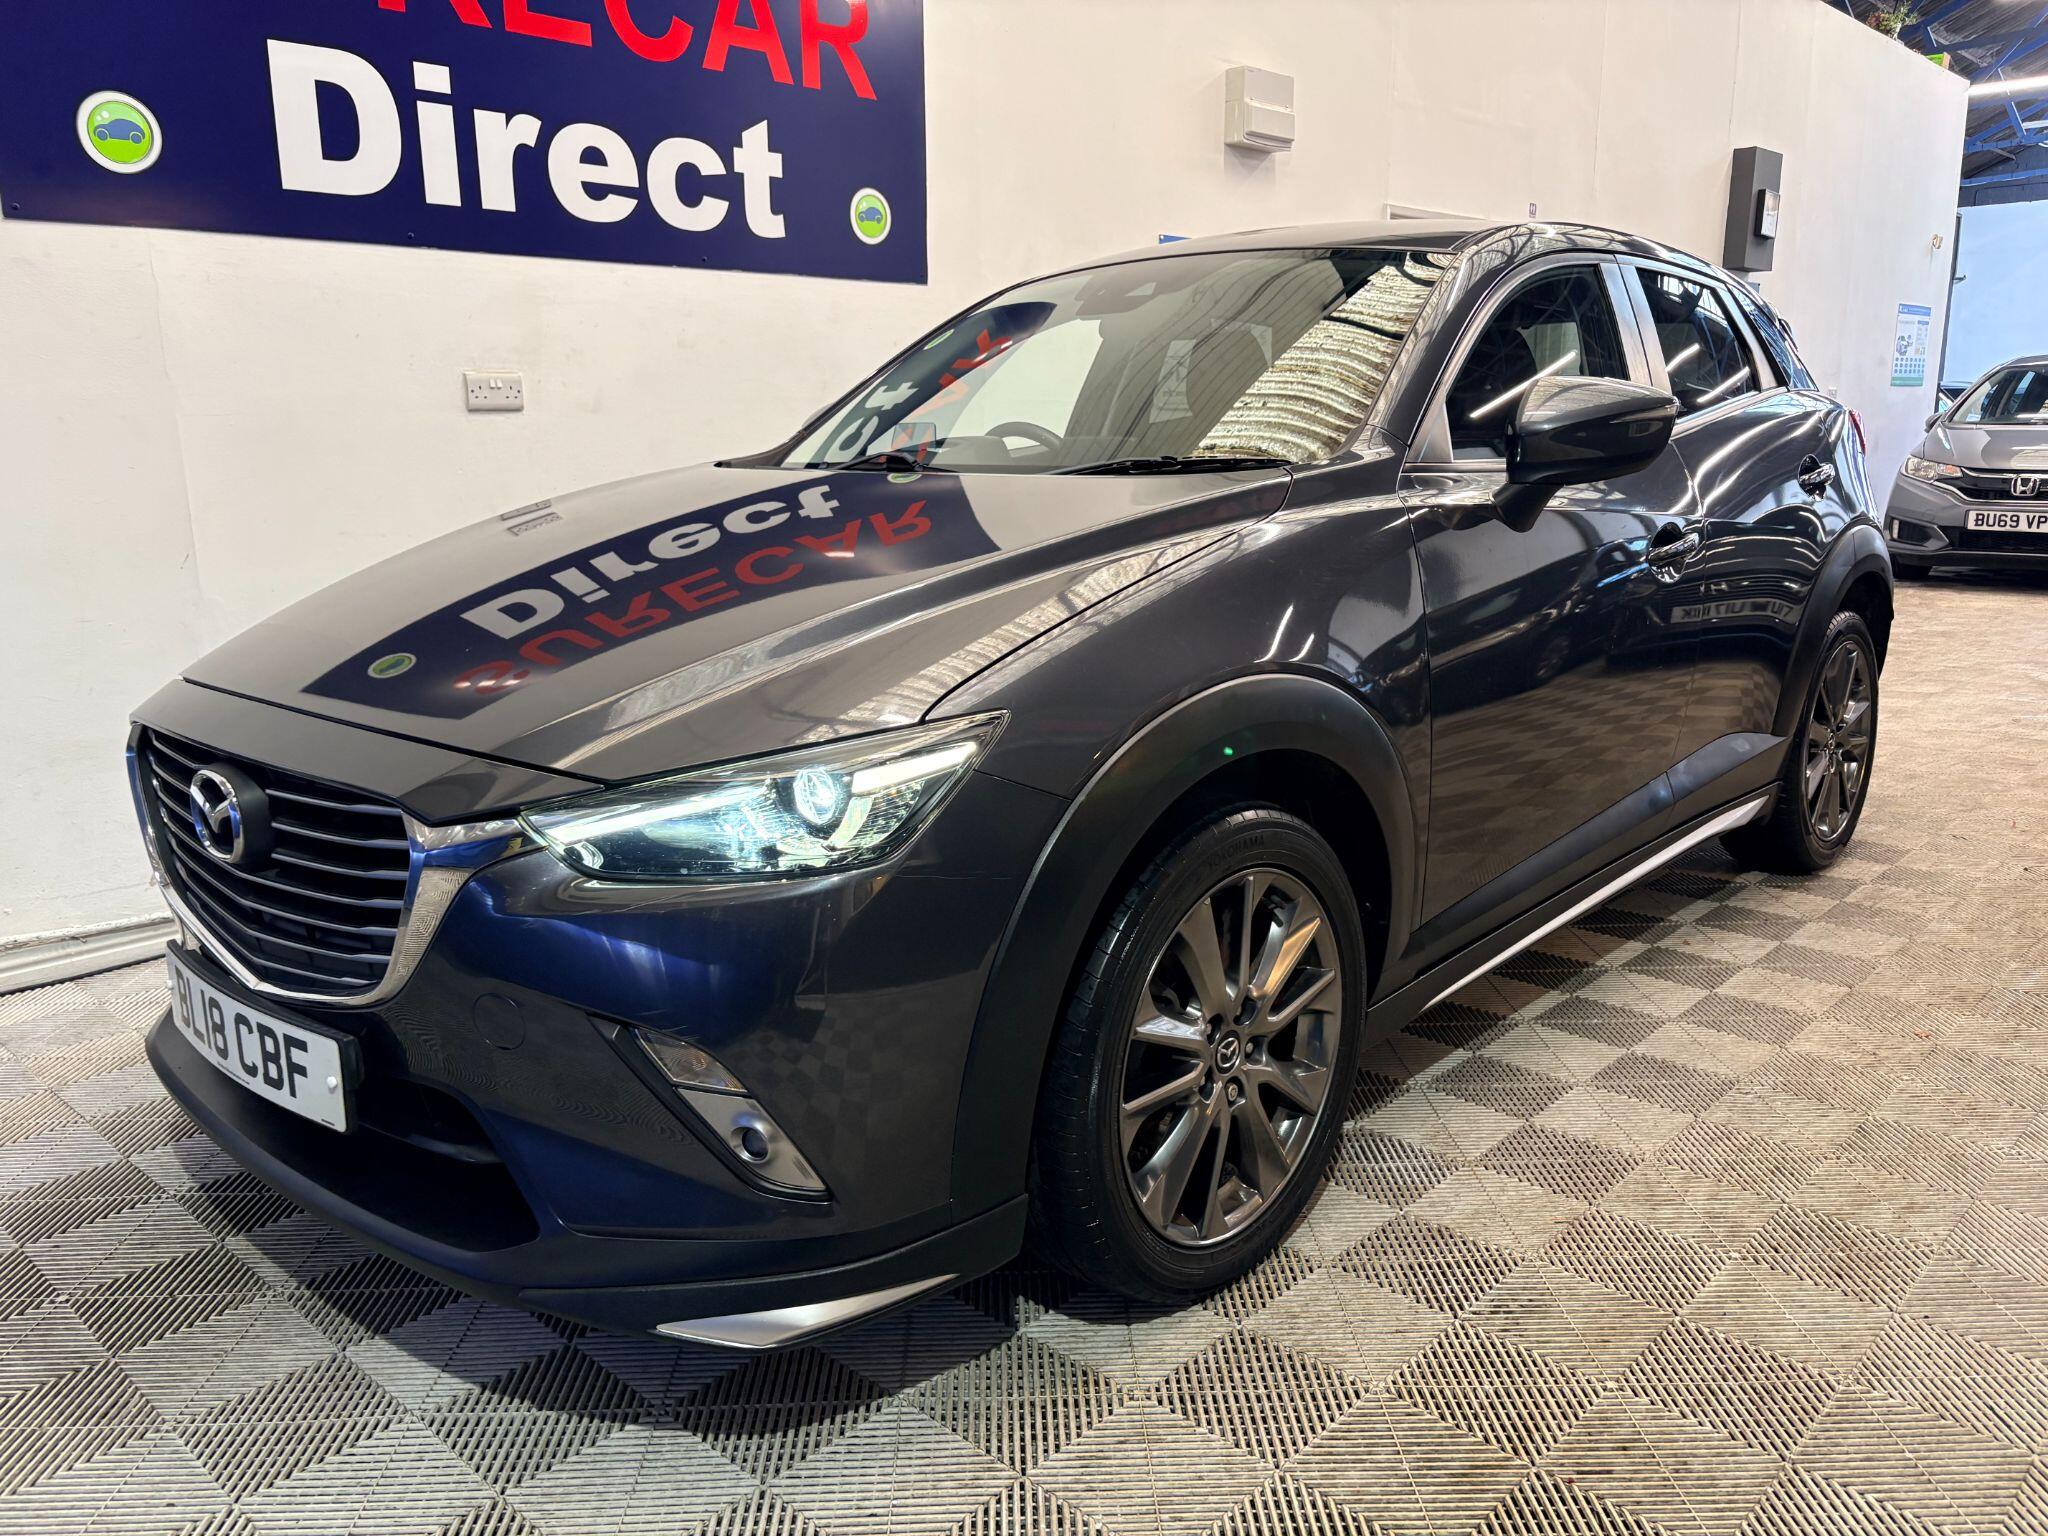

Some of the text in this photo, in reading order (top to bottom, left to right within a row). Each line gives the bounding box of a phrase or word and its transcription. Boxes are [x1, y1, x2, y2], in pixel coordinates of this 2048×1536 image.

[266, 38, 787, 239] Direct
[1974, 513, 2020, 528] BU69
[174, 965, 309, 1099] BL18 CBF
